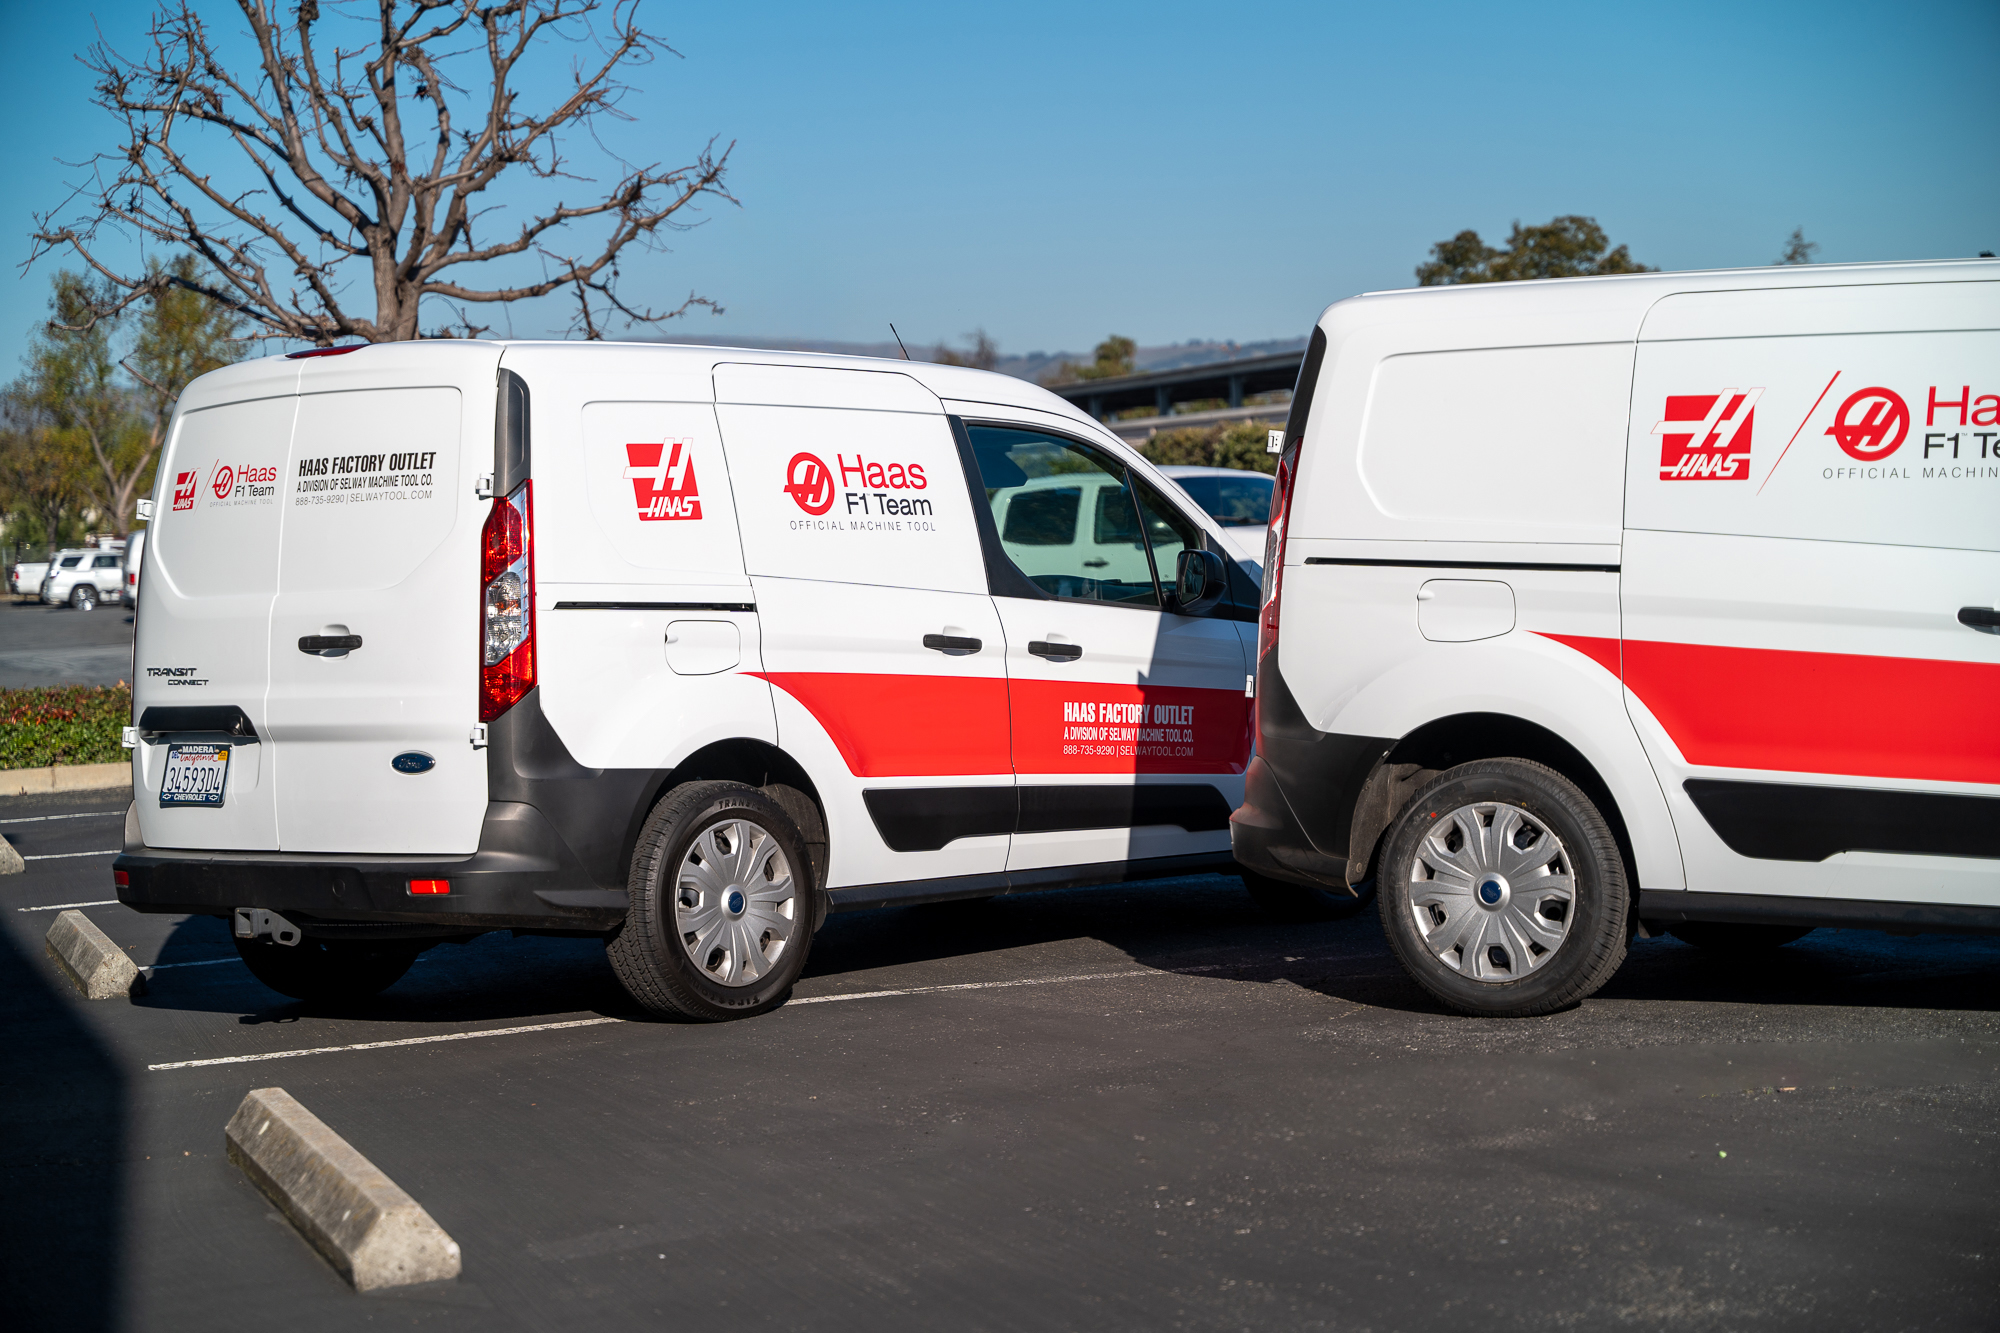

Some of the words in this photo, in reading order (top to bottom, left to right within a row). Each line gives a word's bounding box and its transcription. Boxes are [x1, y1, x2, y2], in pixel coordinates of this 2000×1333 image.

[298, 457, 329, 477] HAAS
[331, 454, 386, 475] FACTORY
[388, 451, 437, 471] OUTLET
[837, 453, 928, 490] Haas
[1660, 453, 1750, 477] HAAS
[1822, 467, 1911, 479] OFFICIAL
[1922, 466, 1999, 479] MACHIN
[236, 464, 277, 484] Haas
[234, 485, 246, 498] F1
[248, 484, 275, 497] Team
[296, 480, 302, 493] A
[302, 479, 329, 493] DIVISION
[330, 478, 339, 490] OF
[340, 476, 368, 490] SELWAY
[368, 475, 400, 488] MACHINE
[400, 474, 419, 487] TOOL
[420, 473, 433, 486] CO.
[209, 500, 232, 508] OFFICIAL
[295, 494, 345, 506] 888-735-9290
[349, 489, 433, 503] SELWAYTOOL.COM
[638, 495, 700, 517] HAAS
[845, 492, 869, 515] F1
[873, 493, 933, 516] Team
[789, 520, 845, 531] OFFICIAL
[850, 521, 902, 531] MACHINE
[906, 521, 937, 532] TOOL
[146, 667, 198, 677] TRANSIT
[1064, 701, 1096, 723] HAAS
[1098, 703, 1151, 724] FACTORY
[1153, 704, 1195, 725] OUTLET
[1063, 726, 1070, 740] A
[1070, 726, 1098, 741] DIVISION
[1098, 727, 1109, 741] OF
[1109, 727, 1136, 741] SELWAY
[1136, 728, 1165, 742] MACHINE
[1165, 728, 1183, 743] TOOL
[1183, 728, 1194, 743] CO.
[182, 745, 214, 754] MADERA
[1062, 744, 1115, 756] 888-735-9290
[1119, 745, 1194, 757] SELWAYTOOL.COM
[167, 766, 221, 793] 34593D4
[173, 793, 207, 801] CHEVROLET
